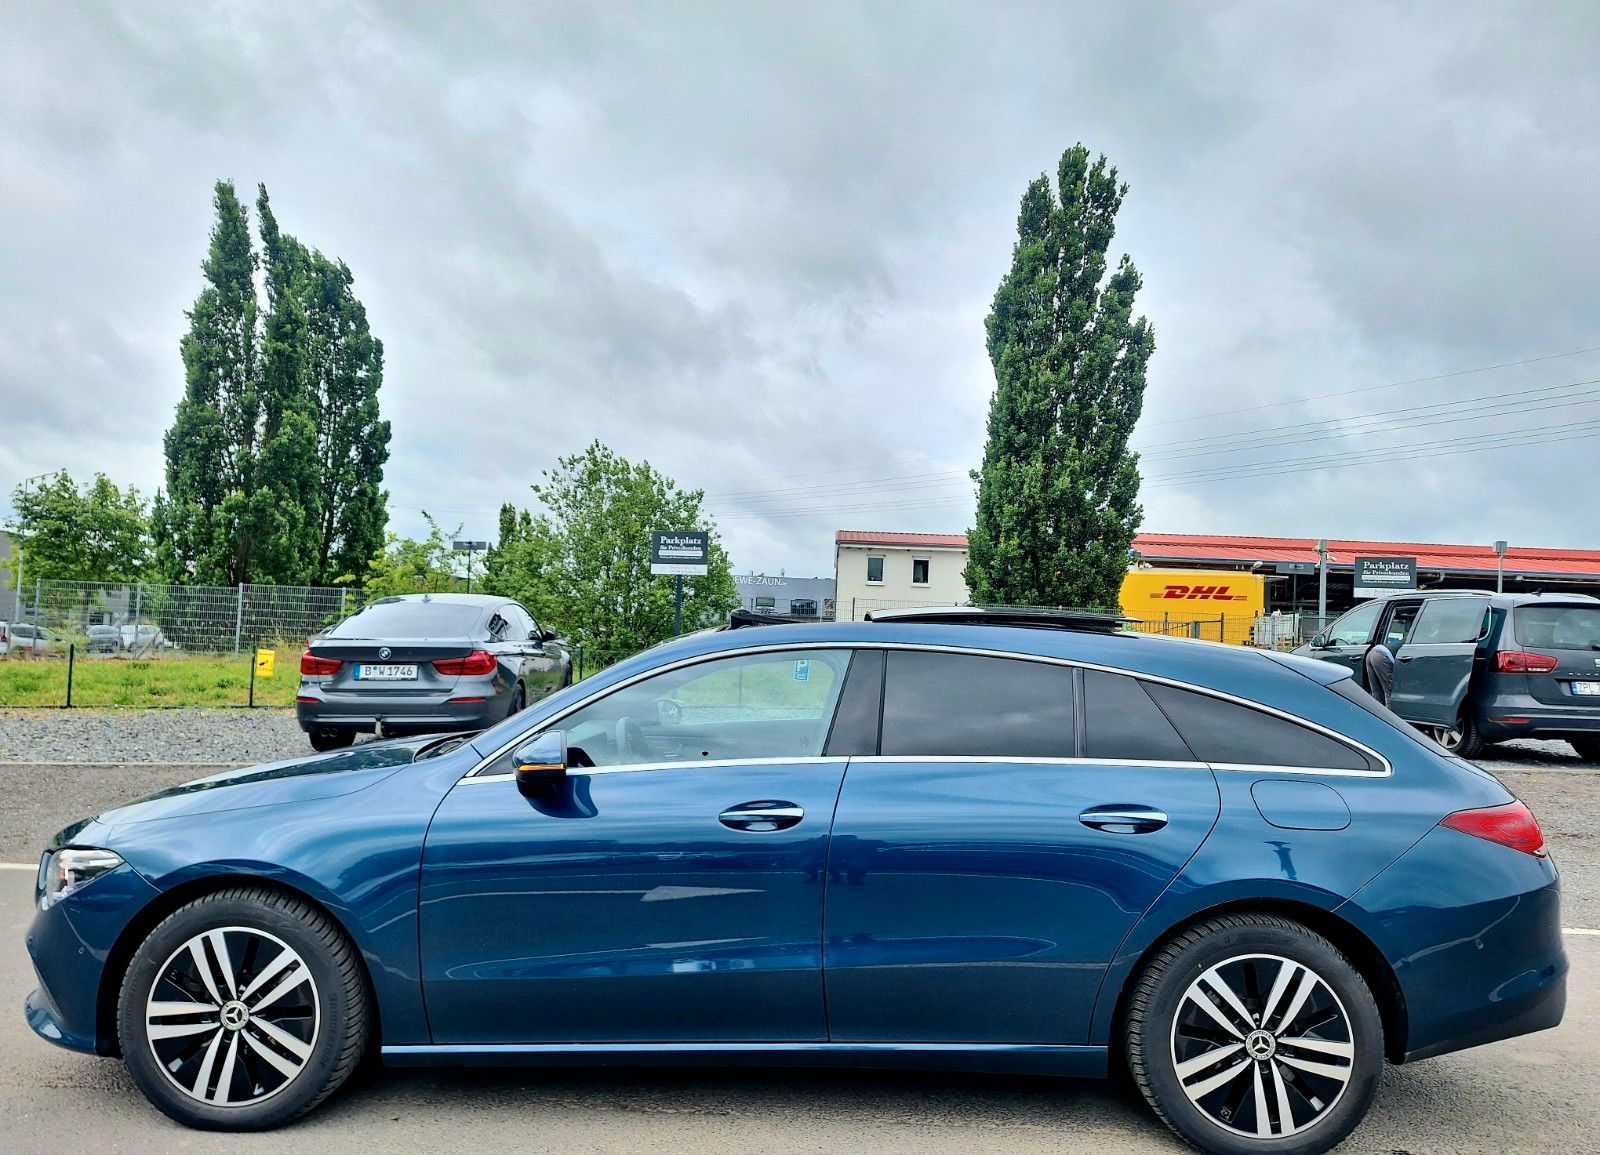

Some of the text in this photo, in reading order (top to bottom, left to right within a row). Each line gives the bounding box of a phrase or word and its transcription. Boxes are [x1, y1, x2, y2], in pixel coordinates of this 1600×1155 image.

[660, 535, 701, 545] Parkplatz
[1363, 561, 1409, 571] Parkplatz
[1163, 585, 1234, 600] DHL
